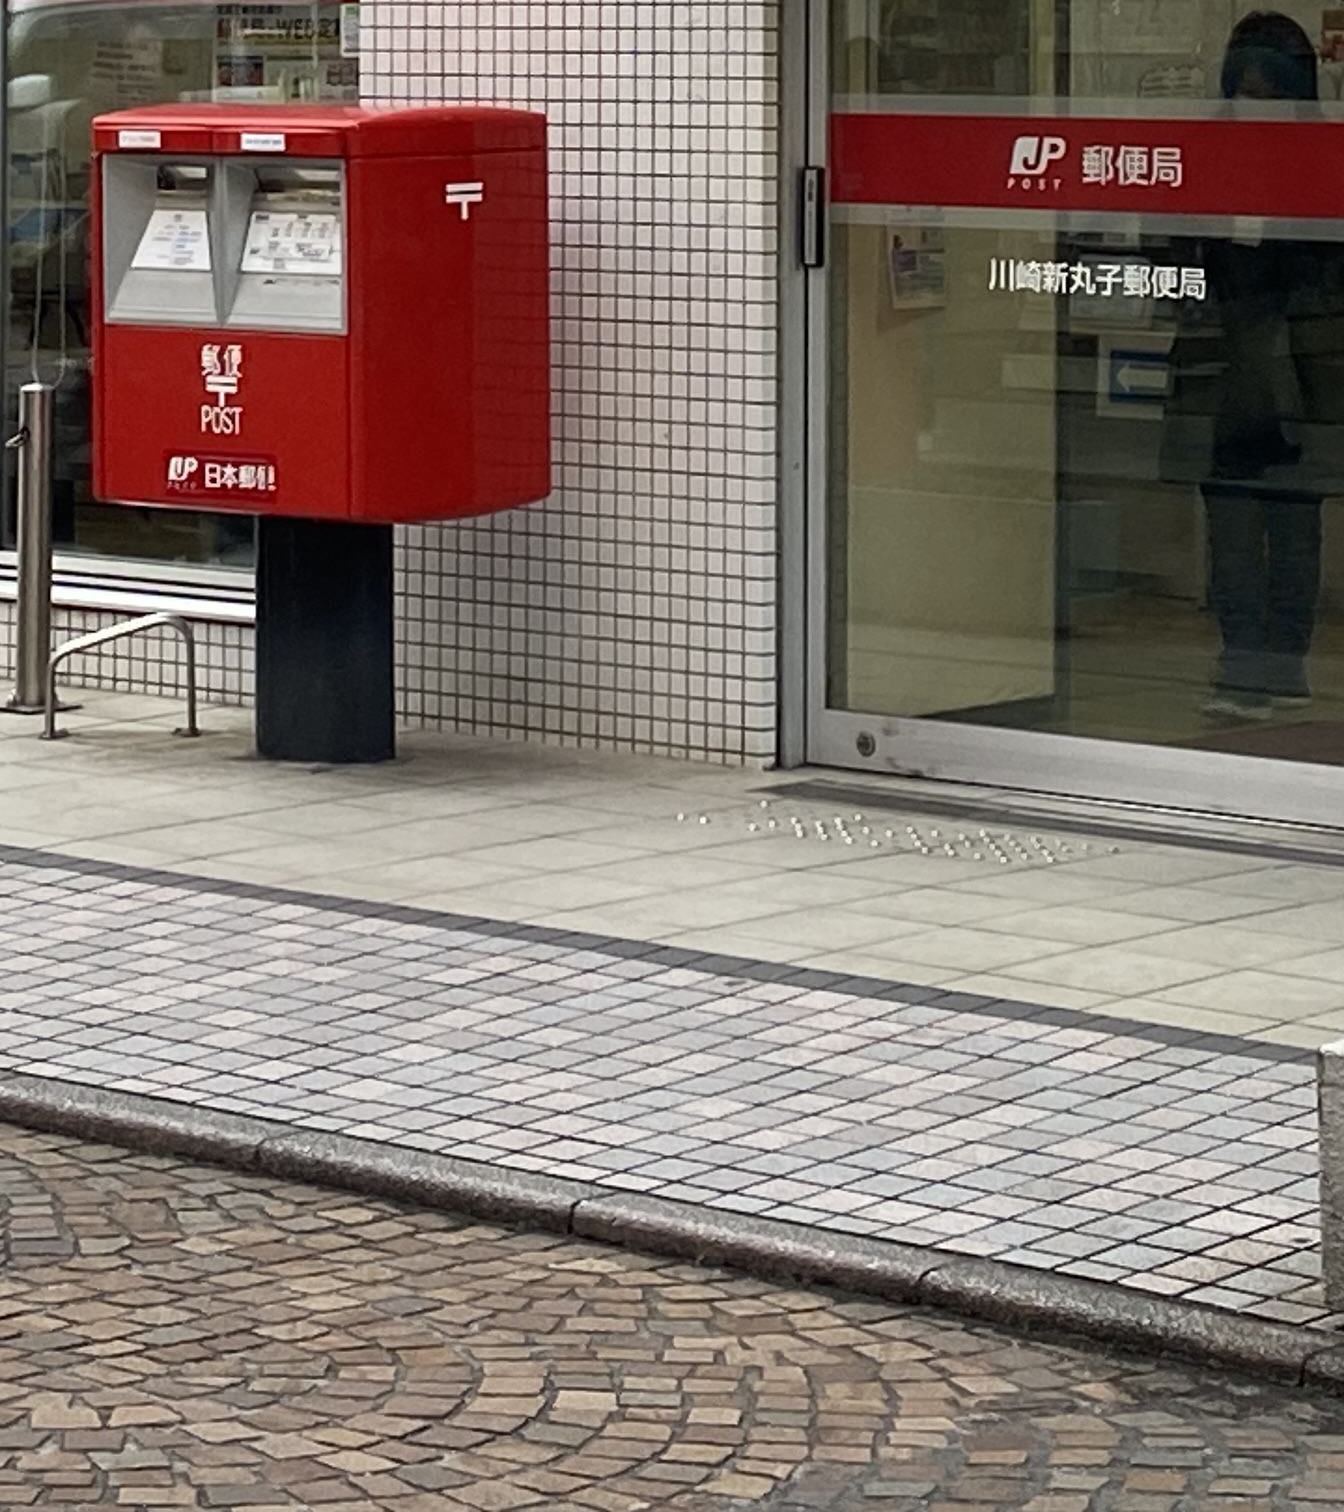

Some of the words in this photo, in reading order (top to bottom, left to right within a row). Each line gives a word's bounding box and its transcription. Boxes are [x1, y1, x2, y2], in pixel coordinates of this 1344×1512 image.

[1081, 144, 1183, 188] 郵便局
[1006, 177, 1063, 191] POST
[988, 257, 1208, 302] 川崎新丸子郵便局
[201, 344, 243, 377] 郵便
[201, 405, 243, 435] POST
[205, 464, 276, 491] 日本郵便
